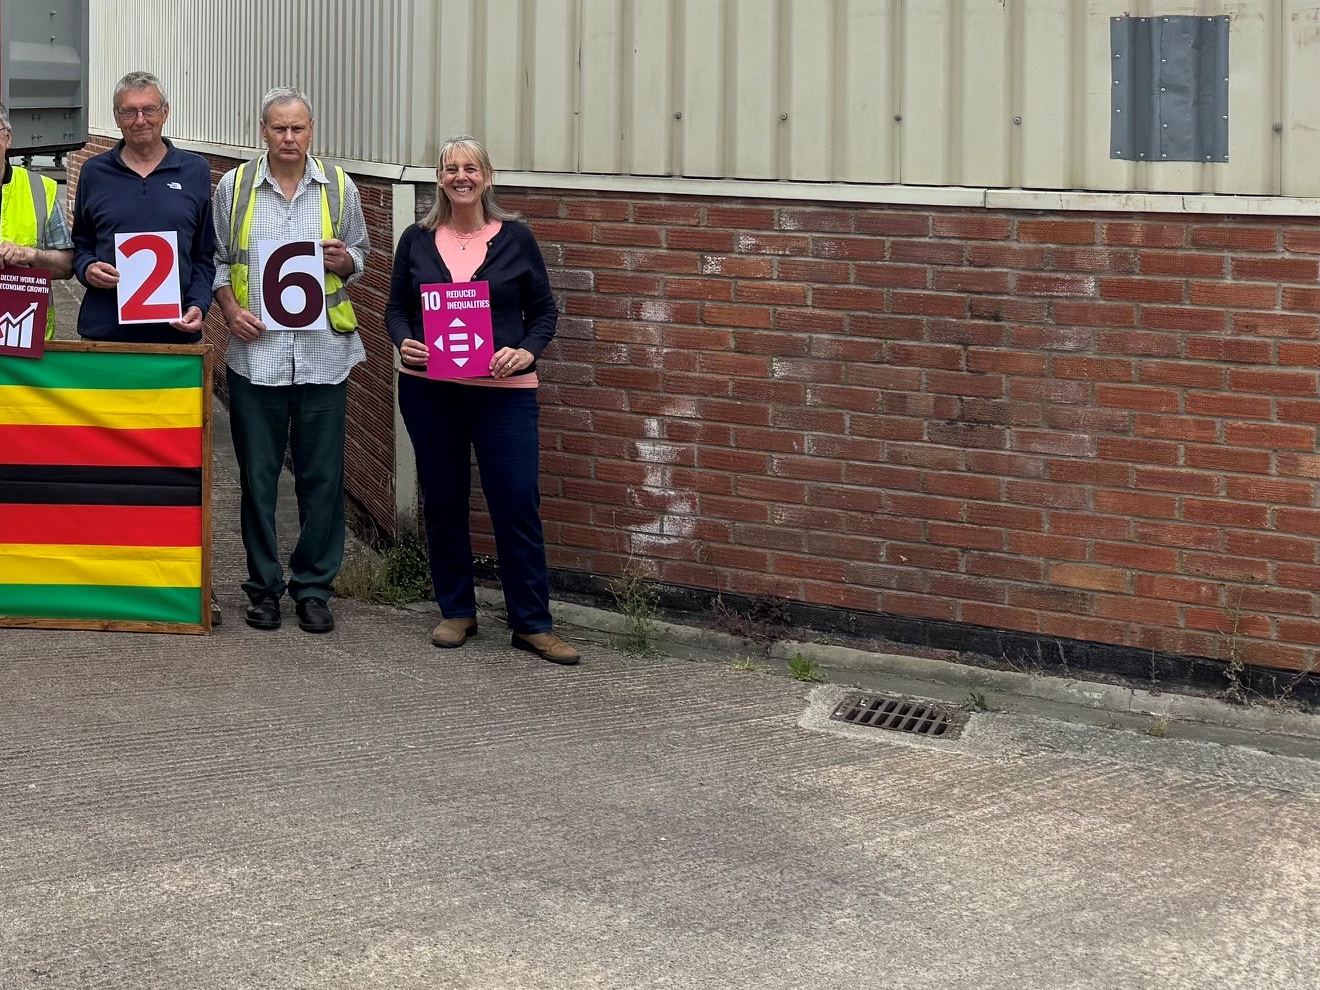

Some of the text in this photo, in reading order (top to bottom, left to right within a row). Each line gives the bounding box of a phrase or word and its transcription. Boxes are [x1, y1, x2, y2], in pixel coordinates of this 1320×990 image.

[1, 274, 18, 282] DECENT
[20, 276, 34, 284] WORK
[118, 235, 179, 320] 2
[0, 283, 26, 292] ECONOMIC
[262, 242, 325, 328] 6
[446, 289, 476, 298] REDUCED
[421, 291, 440, 310] 10
[447, 300, 490, 310] INEQUALITIES
